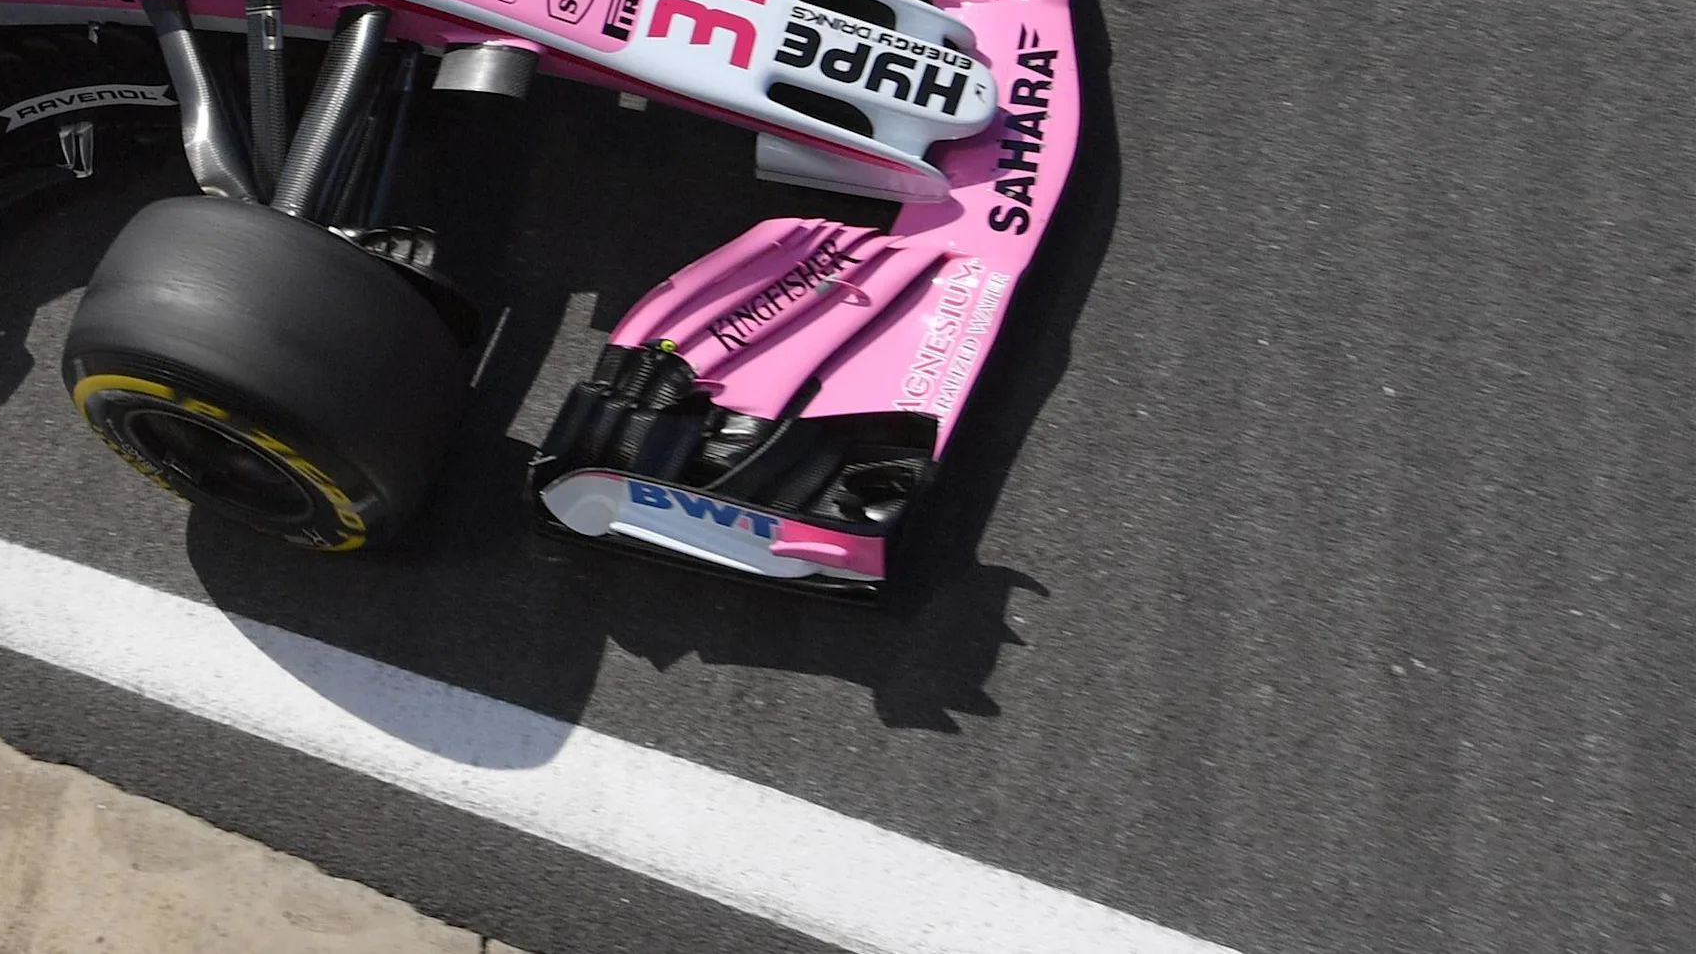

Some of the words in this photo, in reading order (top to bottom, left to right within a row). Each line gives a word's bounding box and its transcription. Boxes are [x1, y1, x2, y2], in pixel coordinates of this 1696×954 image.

[774, 21, 971, 116] HYPE
[791, 5, 874, 40] DRINKS
[16, 89, 159, 119] RAVENOL
[988, 46, 1060, 236] SAHARA
[708, 237, 863, 352] KINGFISHER
[892, 259, 986, 412] AGNESIUM
[626, 478, 779, 540] BWT
